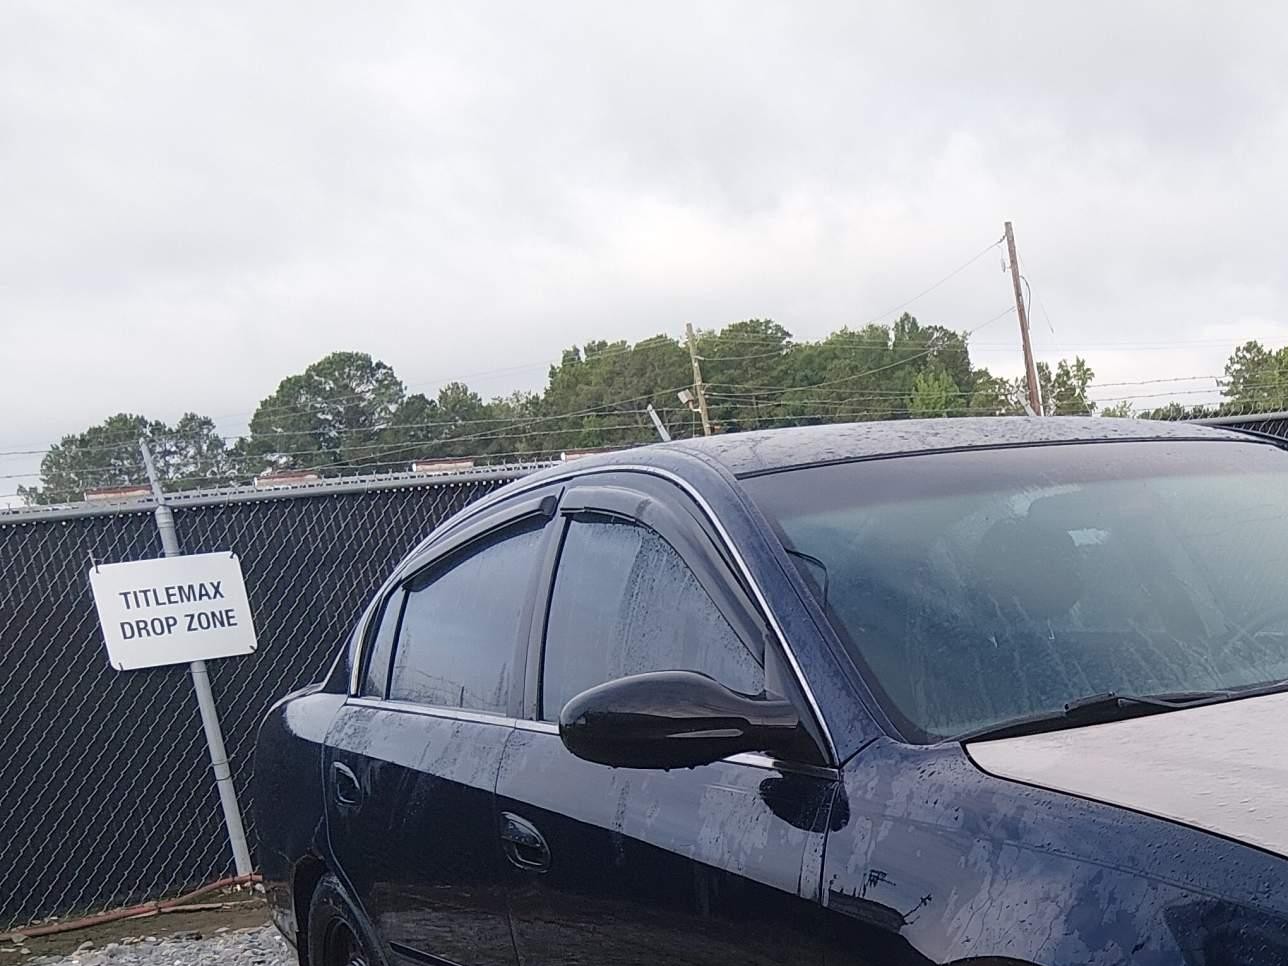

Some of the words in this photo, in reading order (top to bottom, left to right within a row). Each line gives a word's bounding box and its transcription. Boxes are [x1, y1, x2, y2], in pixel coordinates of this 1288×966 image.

[118, 580, 225, 610] TITLEMAX
[120, 615, 178, 640] DROP
[184, 608, 238, 632] ZONE
